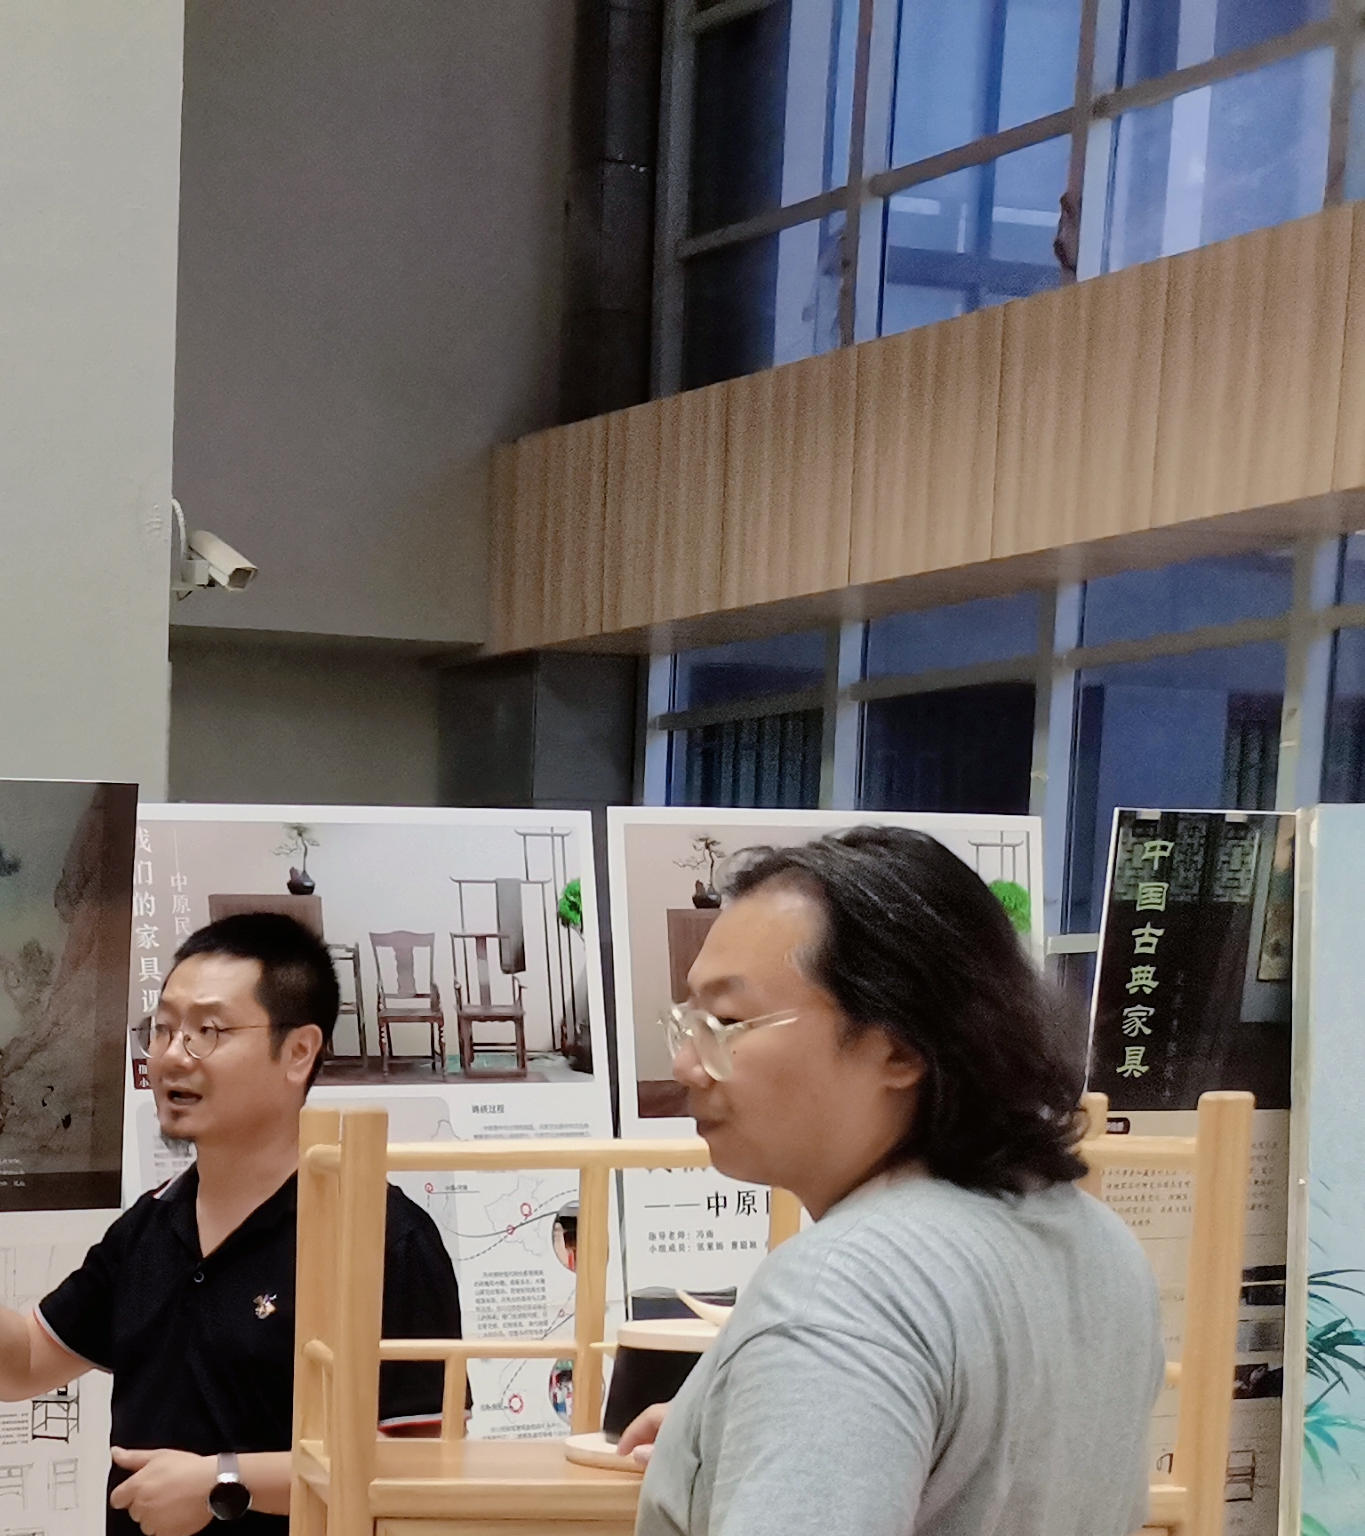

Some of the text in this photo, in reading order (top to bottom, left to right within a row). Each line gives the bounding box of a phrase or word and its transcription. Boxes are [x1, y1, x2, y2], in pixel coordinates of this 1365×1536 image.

[1116, 839, 1175, 1079] 中国古典家具
